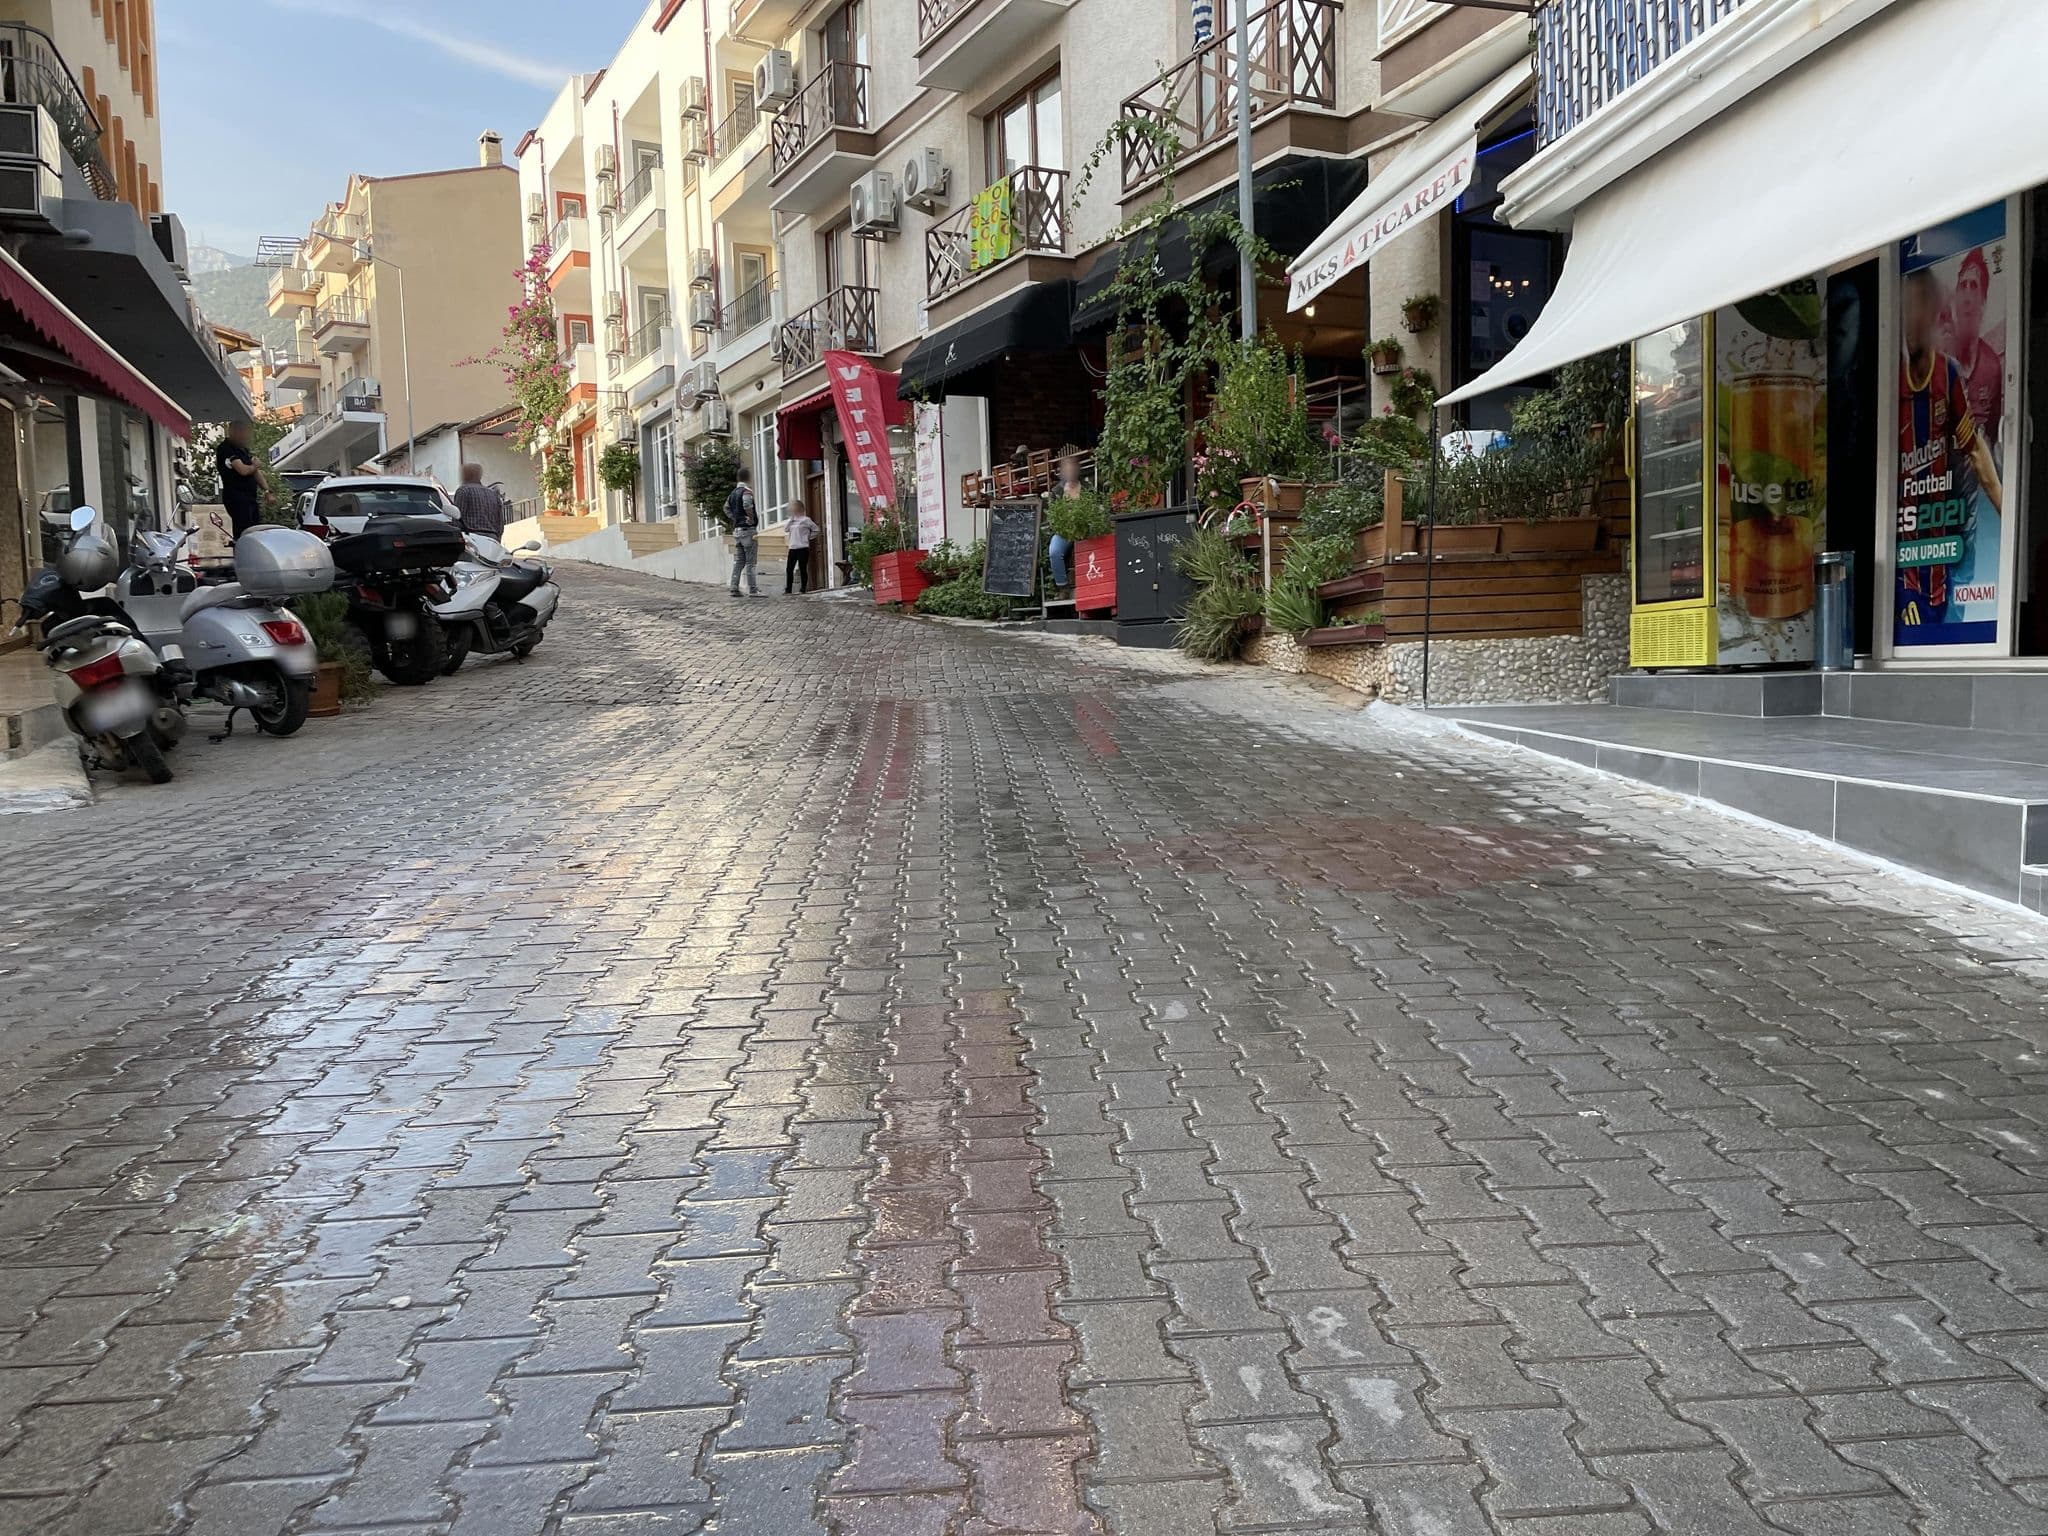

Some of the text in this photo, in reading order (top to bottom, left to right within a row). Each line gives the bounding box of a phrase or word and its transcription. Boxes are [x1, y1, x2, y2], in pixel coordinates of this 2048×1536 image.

[1359, 158, 1468, 252] TİCARET
[1901, 436, 1946, 474] Rakuten
[1904, 470, 1953, 498] Football
[1920, 541, 1957, 559] UPDATE
[1955, 586, 1995, 602] KONAMI
